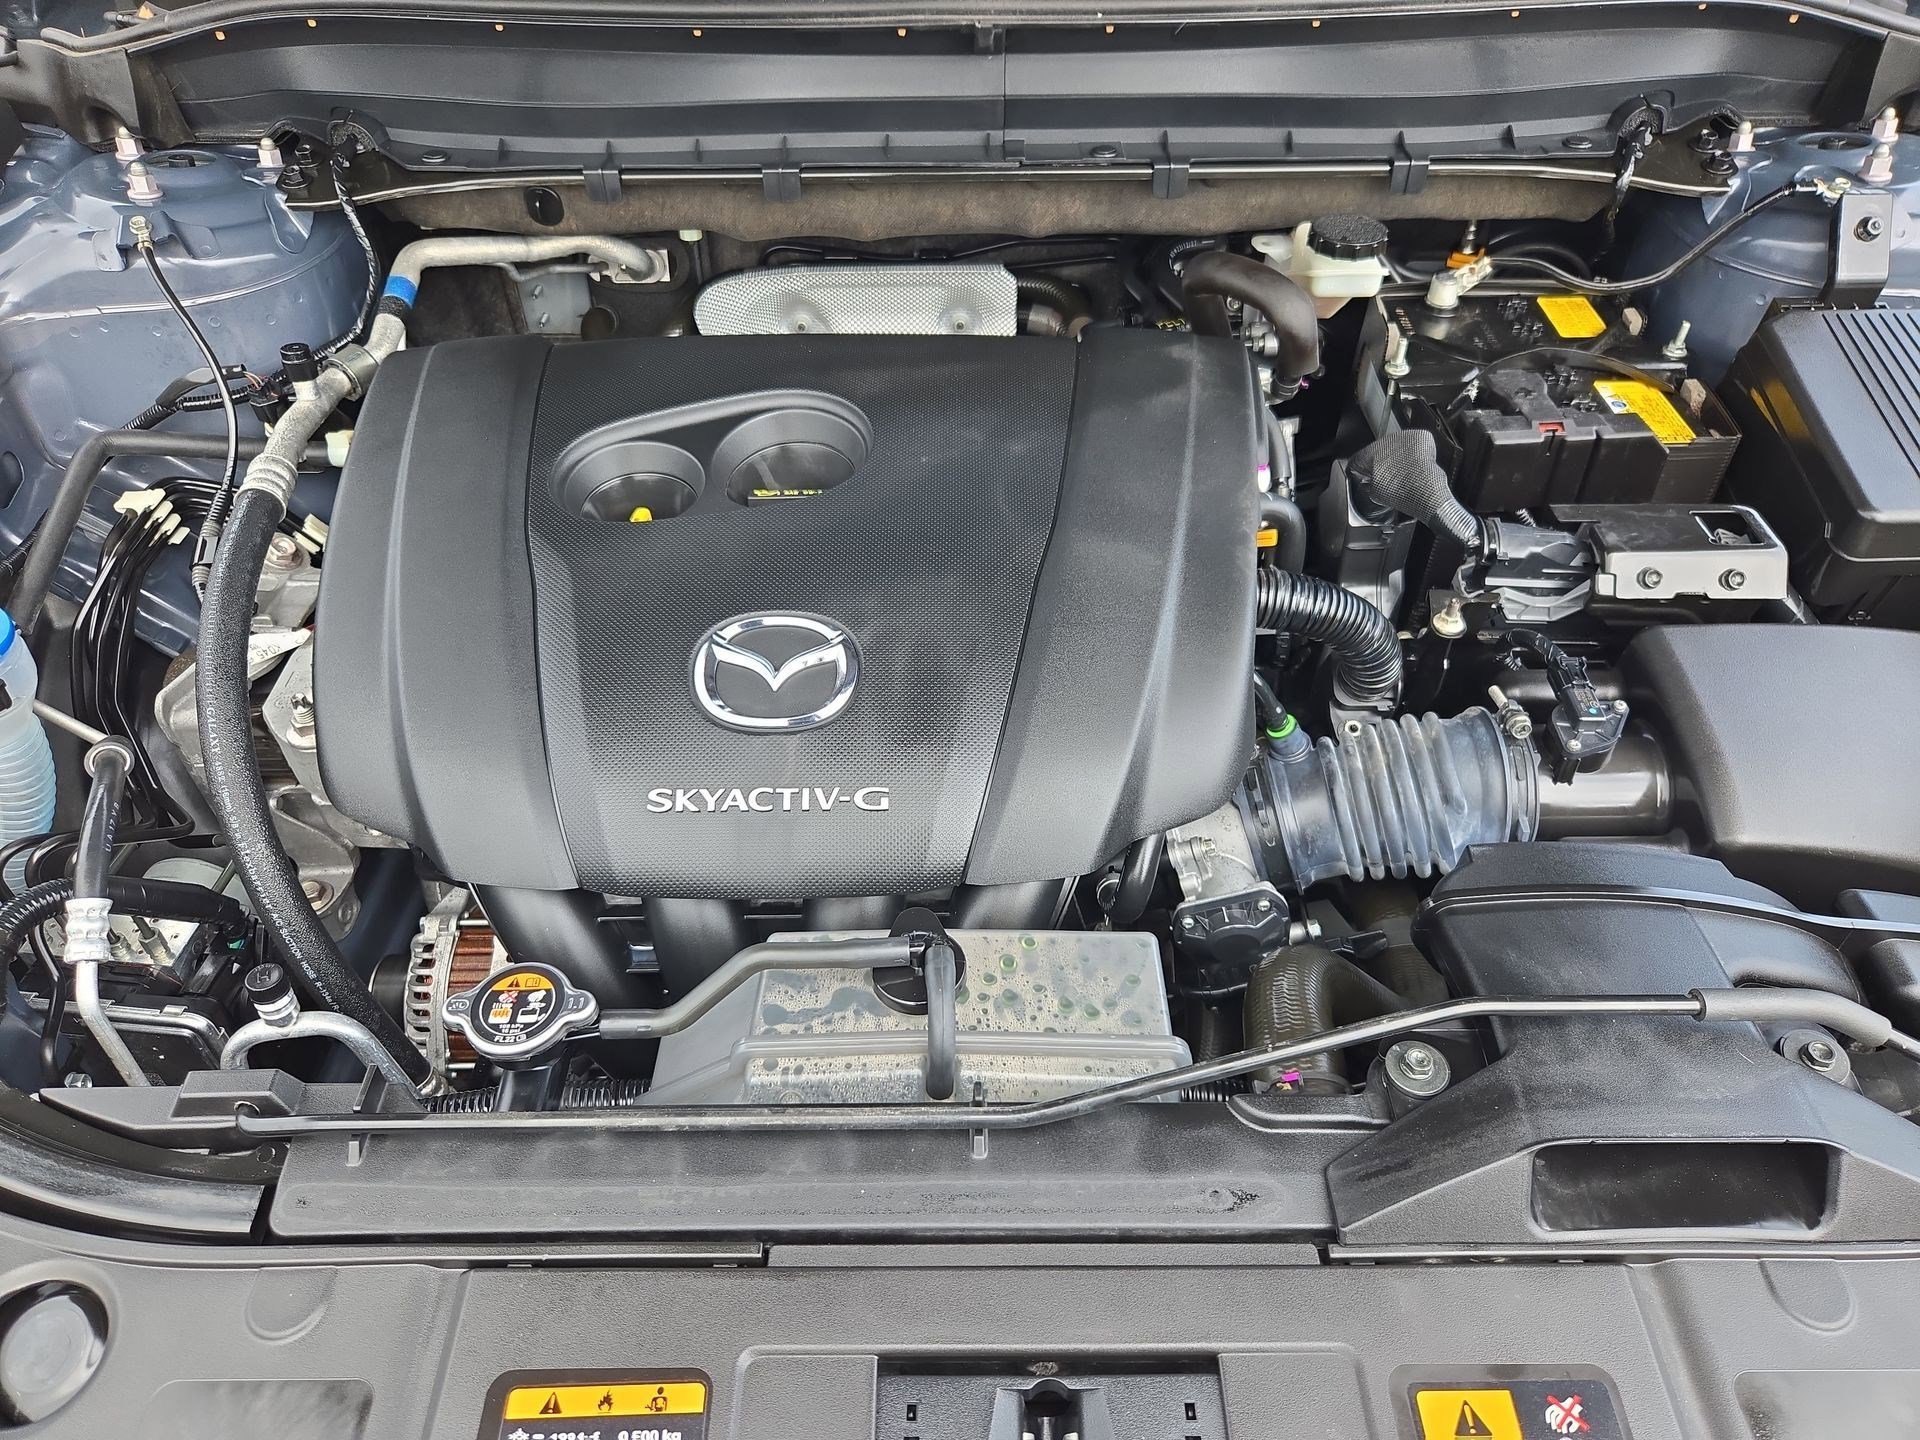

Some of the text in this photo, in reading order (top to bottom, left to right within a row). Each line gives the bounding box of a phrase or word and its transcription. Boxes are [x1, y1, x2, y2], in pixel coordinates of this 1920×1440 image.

[646, 786, 890, 813] SKYACTIV-G
[206, 707, 221, 755] GALAXY
[279, 927, 304, 959] SUCTION
[300, 960, 318, 981] HOSE
[493, 1035, 516, 1043] FL22
